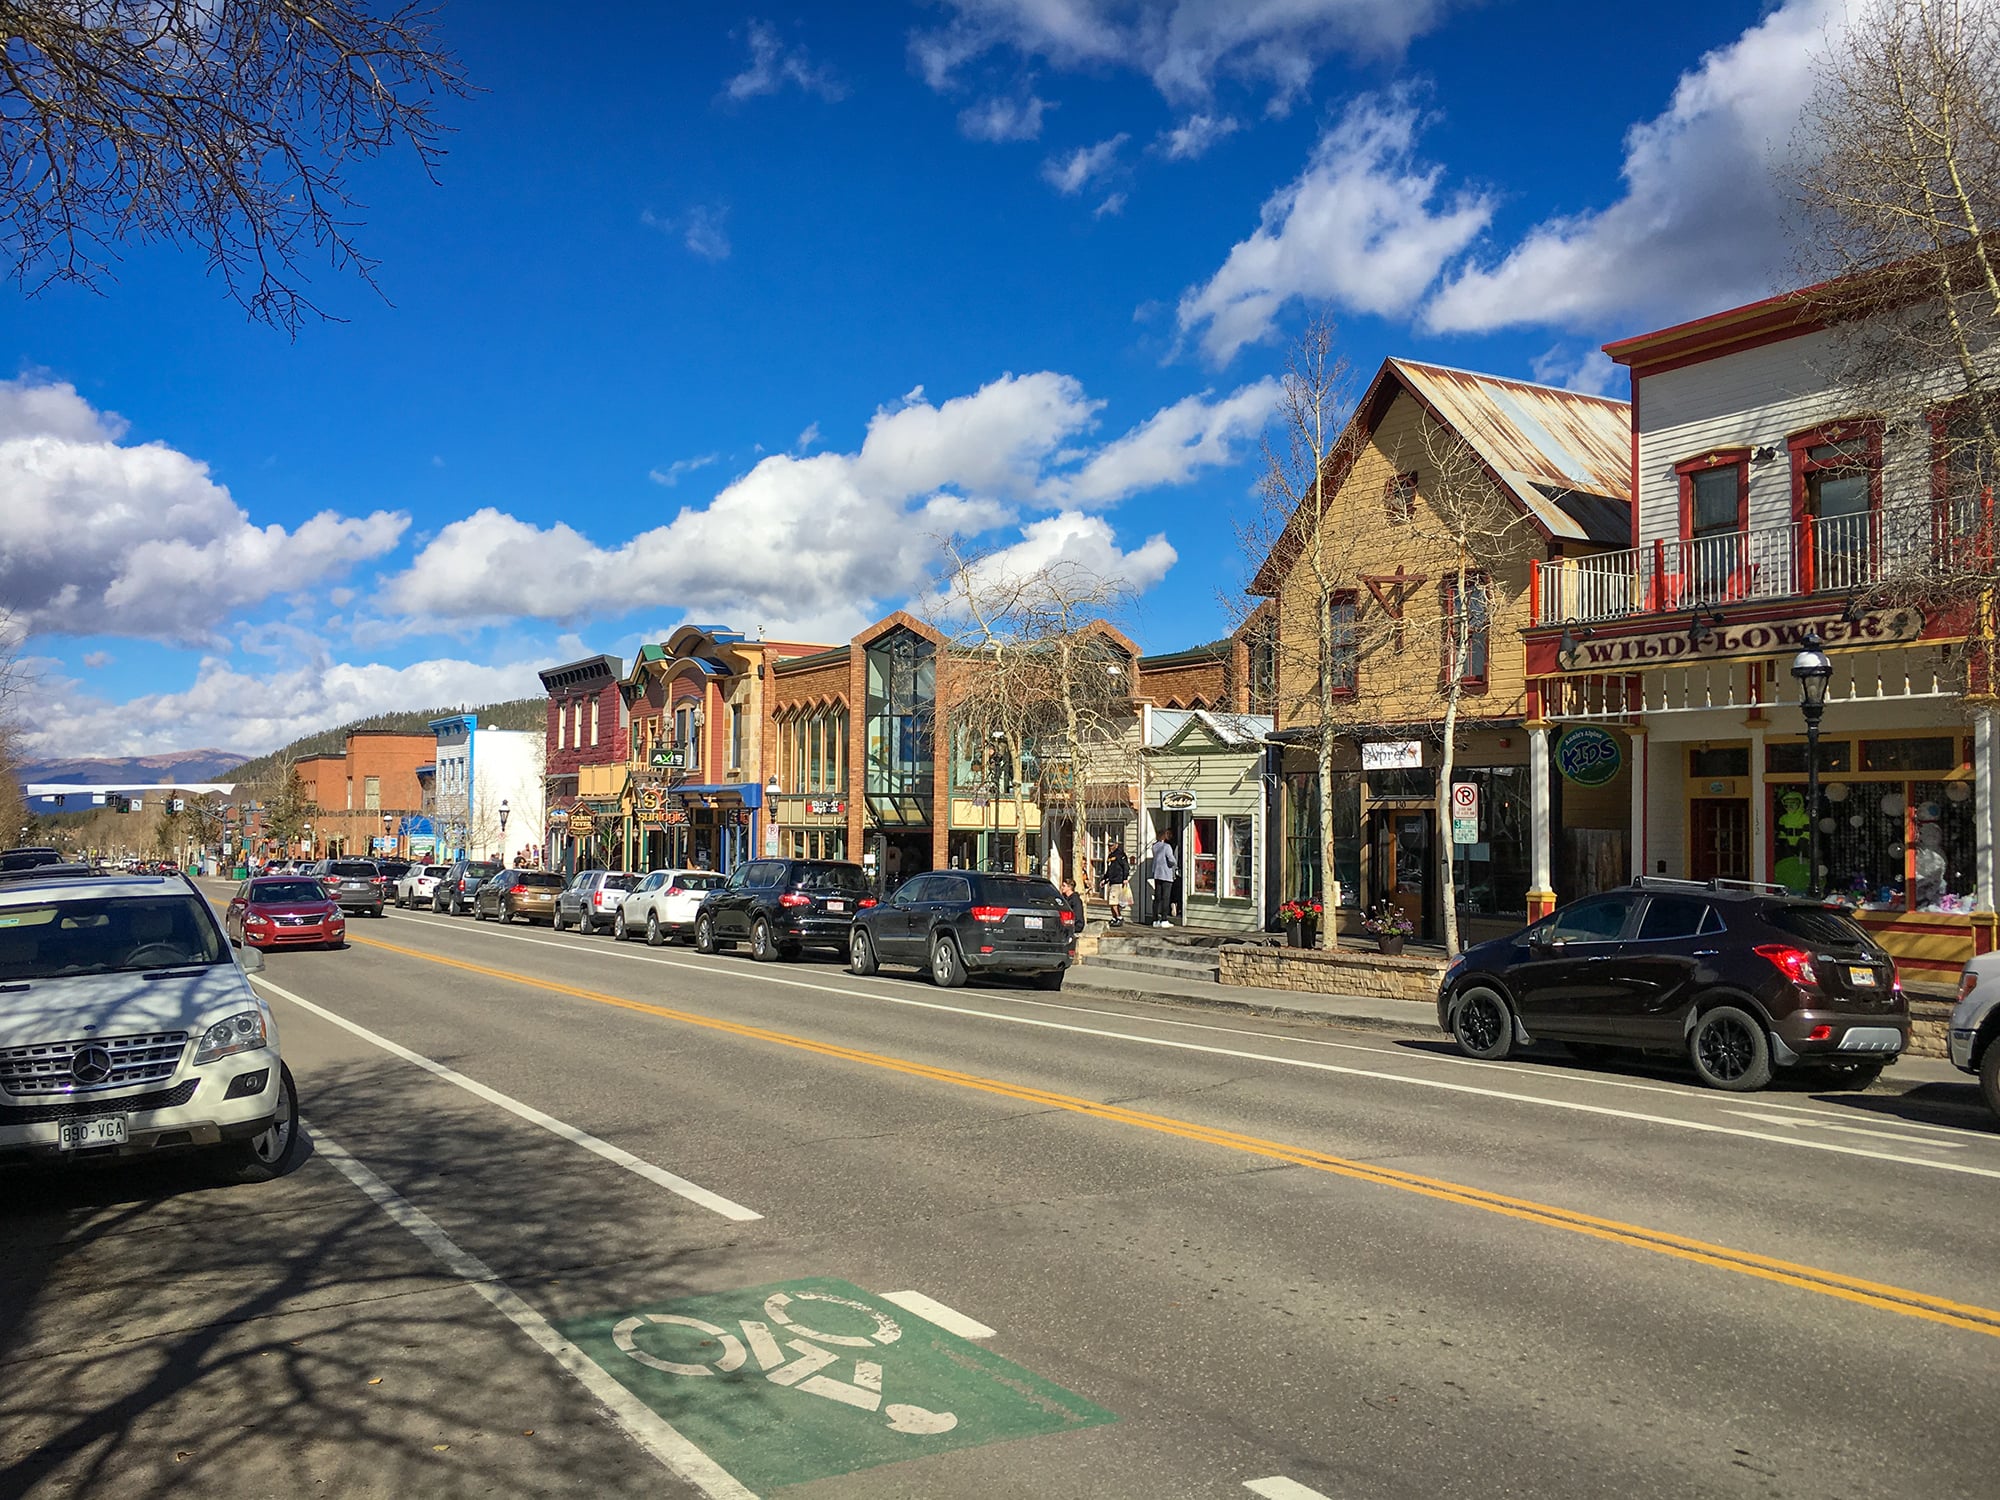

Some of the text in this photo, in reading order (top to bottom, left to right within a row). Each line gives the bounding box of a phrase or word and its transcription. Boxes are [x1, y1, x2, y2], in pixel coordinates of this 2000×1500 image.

[1584, 616, 1884, 663] WILDFLOWER
[652, 751, 684, 764] AXIS
[1562, 738, 1616, 773] KIDS
[639, 810, 685, 825] sunlogic
